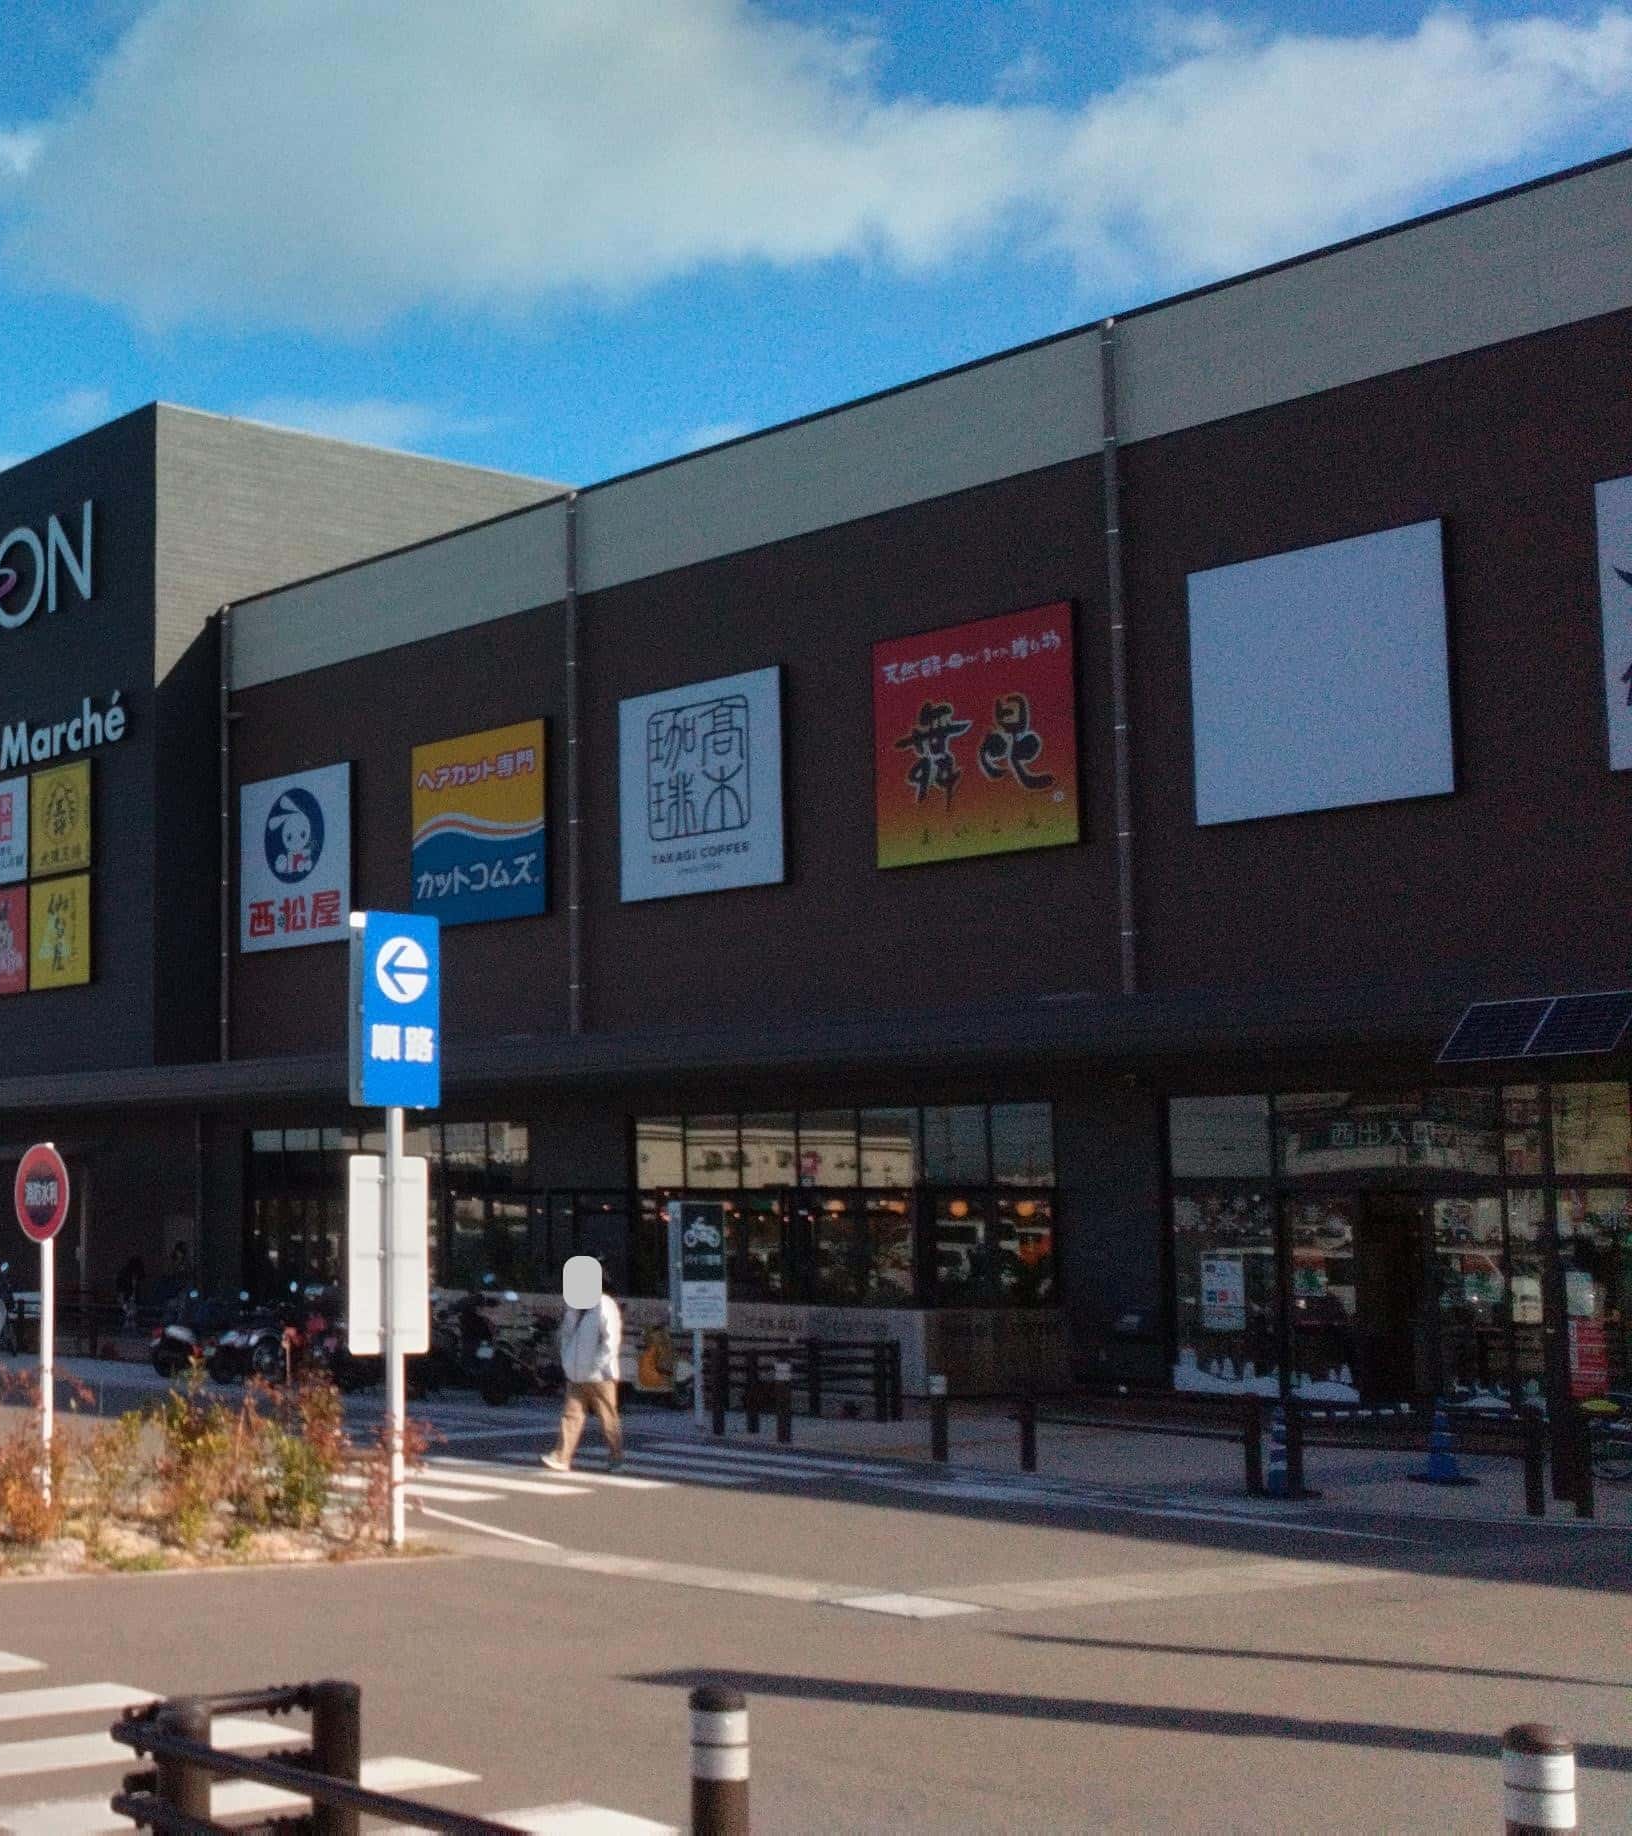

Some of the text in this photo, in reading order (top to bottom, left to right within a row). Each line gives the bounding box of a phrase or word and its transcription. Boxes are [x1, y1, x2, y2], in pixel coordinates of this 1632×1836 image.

[0, 689, 126, 771] Marché
[417, 748, 537, 791] ヘアカット専門
[700, 840, 751, 859] COFFEE
[248, 889, 341, 938] 西松屋
